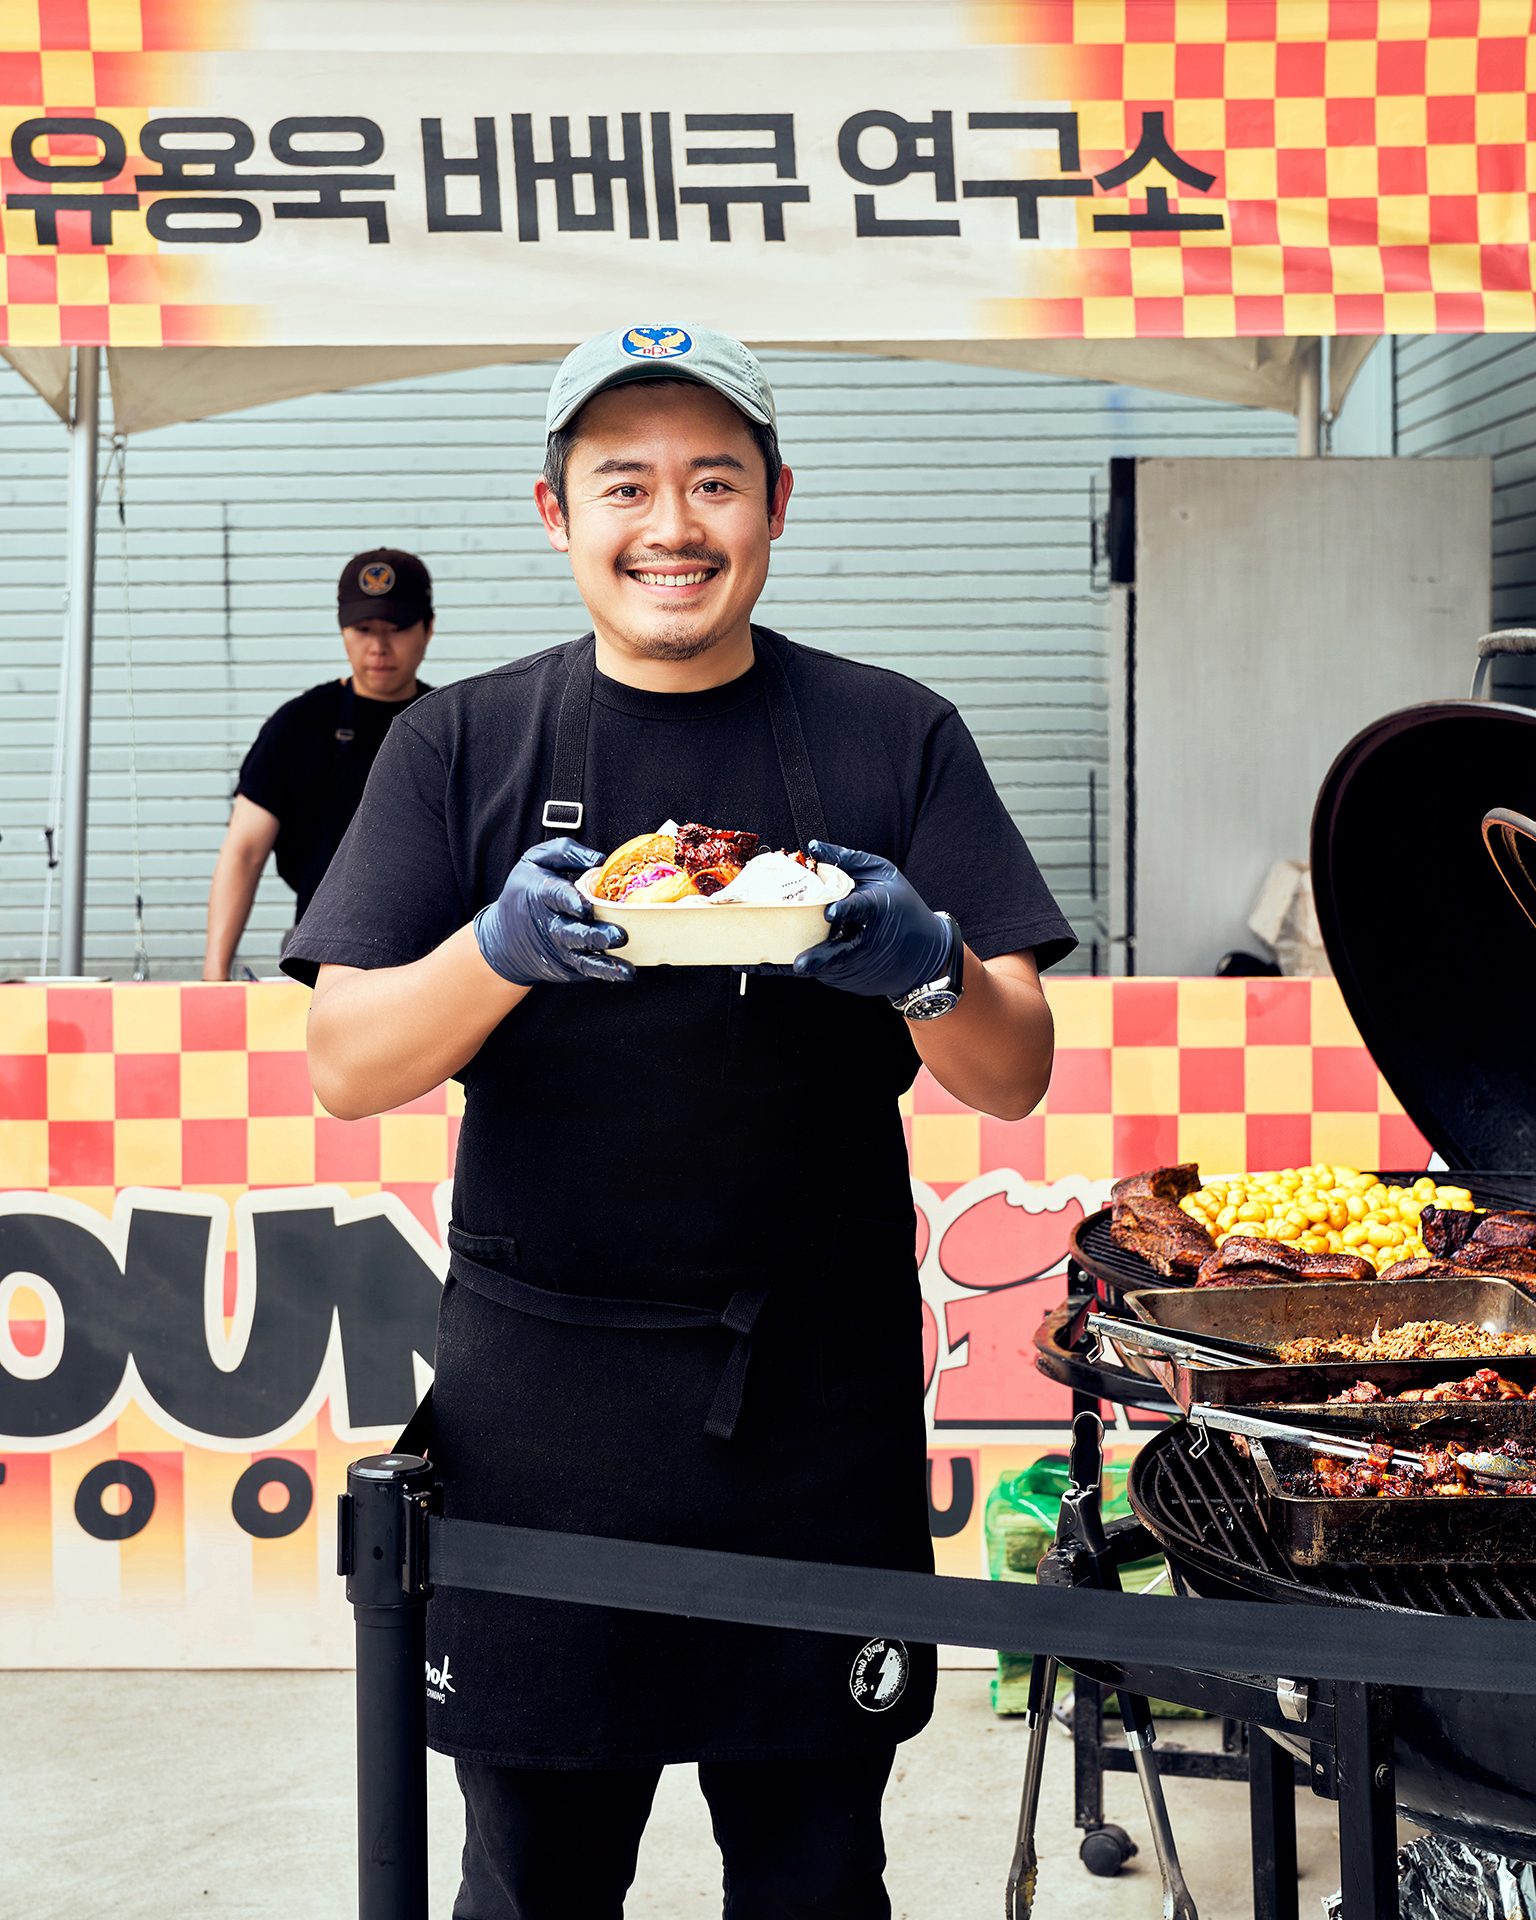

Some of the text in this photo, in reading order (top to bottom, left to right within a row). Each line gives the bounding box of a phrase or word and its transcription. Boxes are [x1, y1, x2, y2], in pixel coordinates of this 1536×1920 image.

[5, 110, 1225, 245] 유용욱 바베큐 연구소
